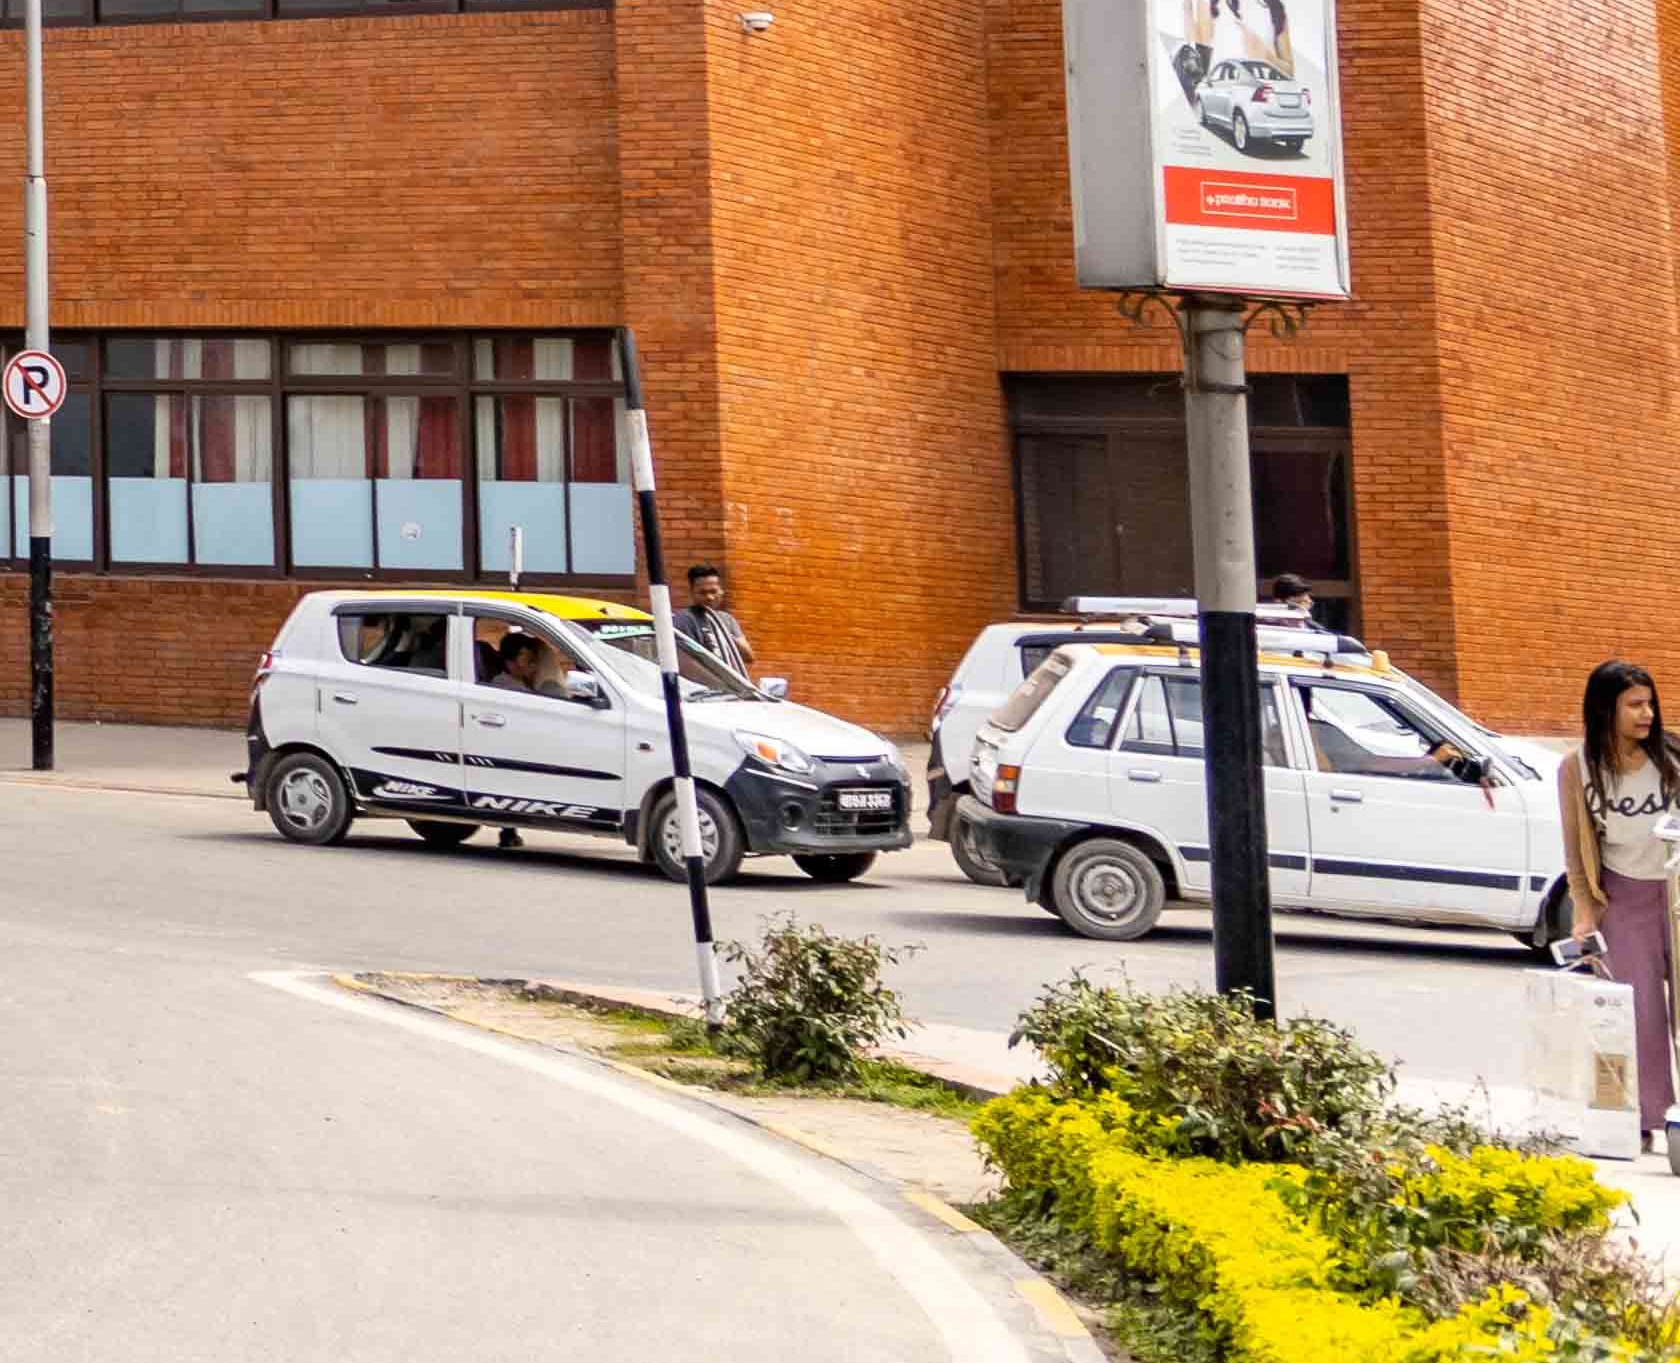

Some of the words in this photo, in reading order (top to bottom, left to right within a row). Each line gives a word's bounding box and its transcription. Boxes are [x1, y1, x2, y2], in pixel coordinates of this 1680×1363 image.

[23, 365, 49, 405] P
[384, 780, 437, 797] NIKE
[471, 795, 600, 820] NIKE
